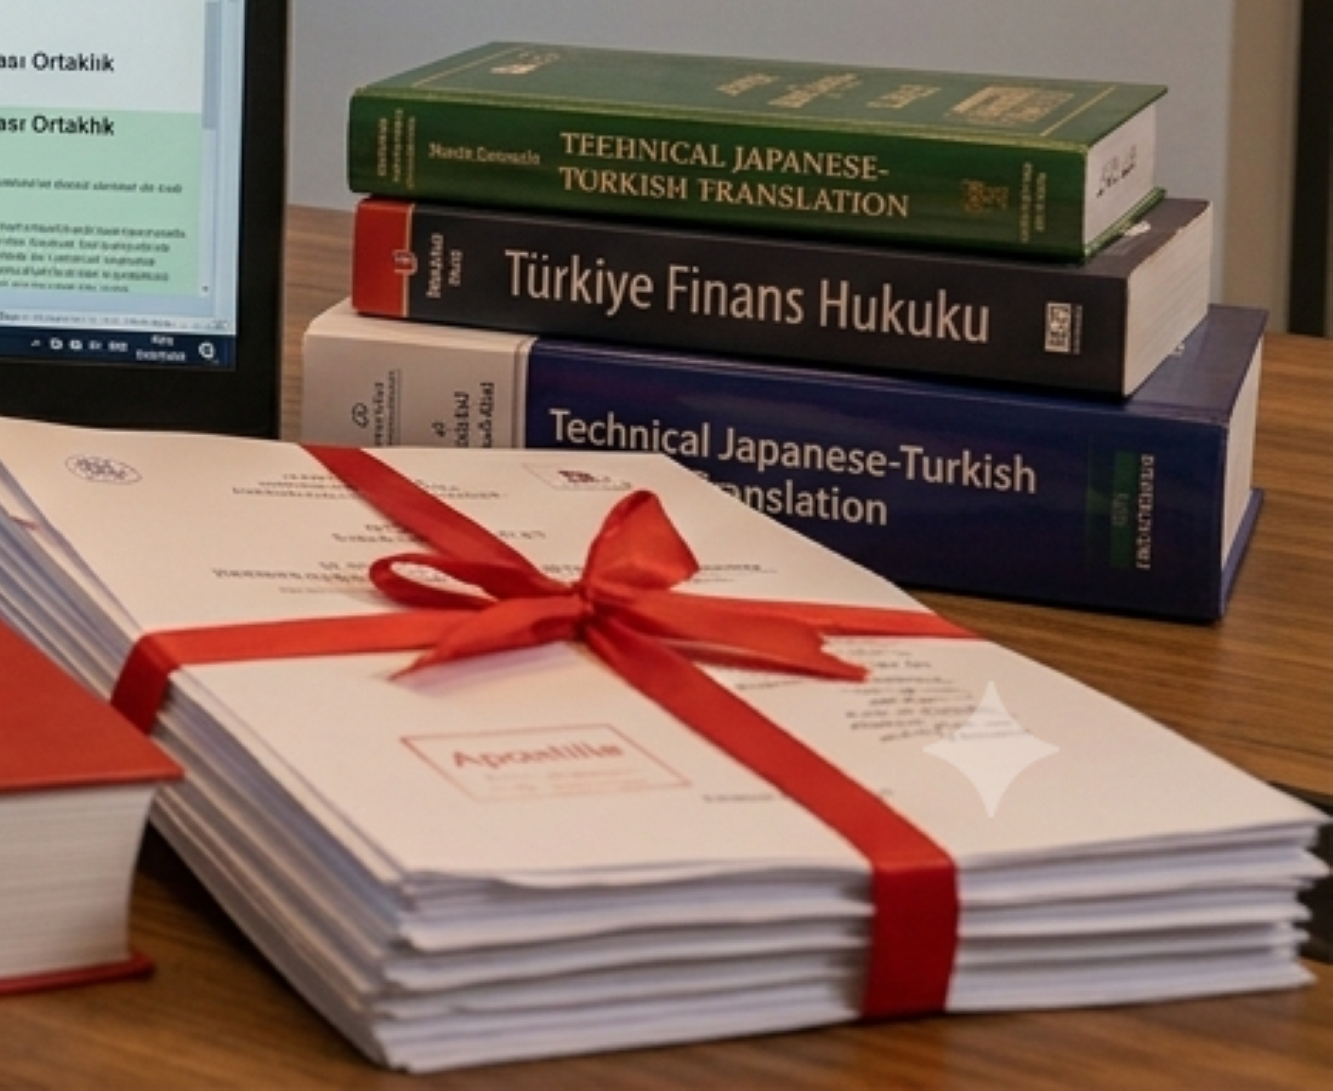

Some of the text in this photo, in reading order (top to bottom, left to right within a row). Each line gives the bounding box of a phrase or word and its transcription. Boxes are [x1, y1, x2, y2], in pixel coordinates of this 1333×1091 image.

[505, 249, 654, 317] Türkiye
[667, 264, 805, 325] Finans
[819, 279, 990, 344] Hukuku
[549, 409, 1038, 494] Technical Japanese-Turkish
